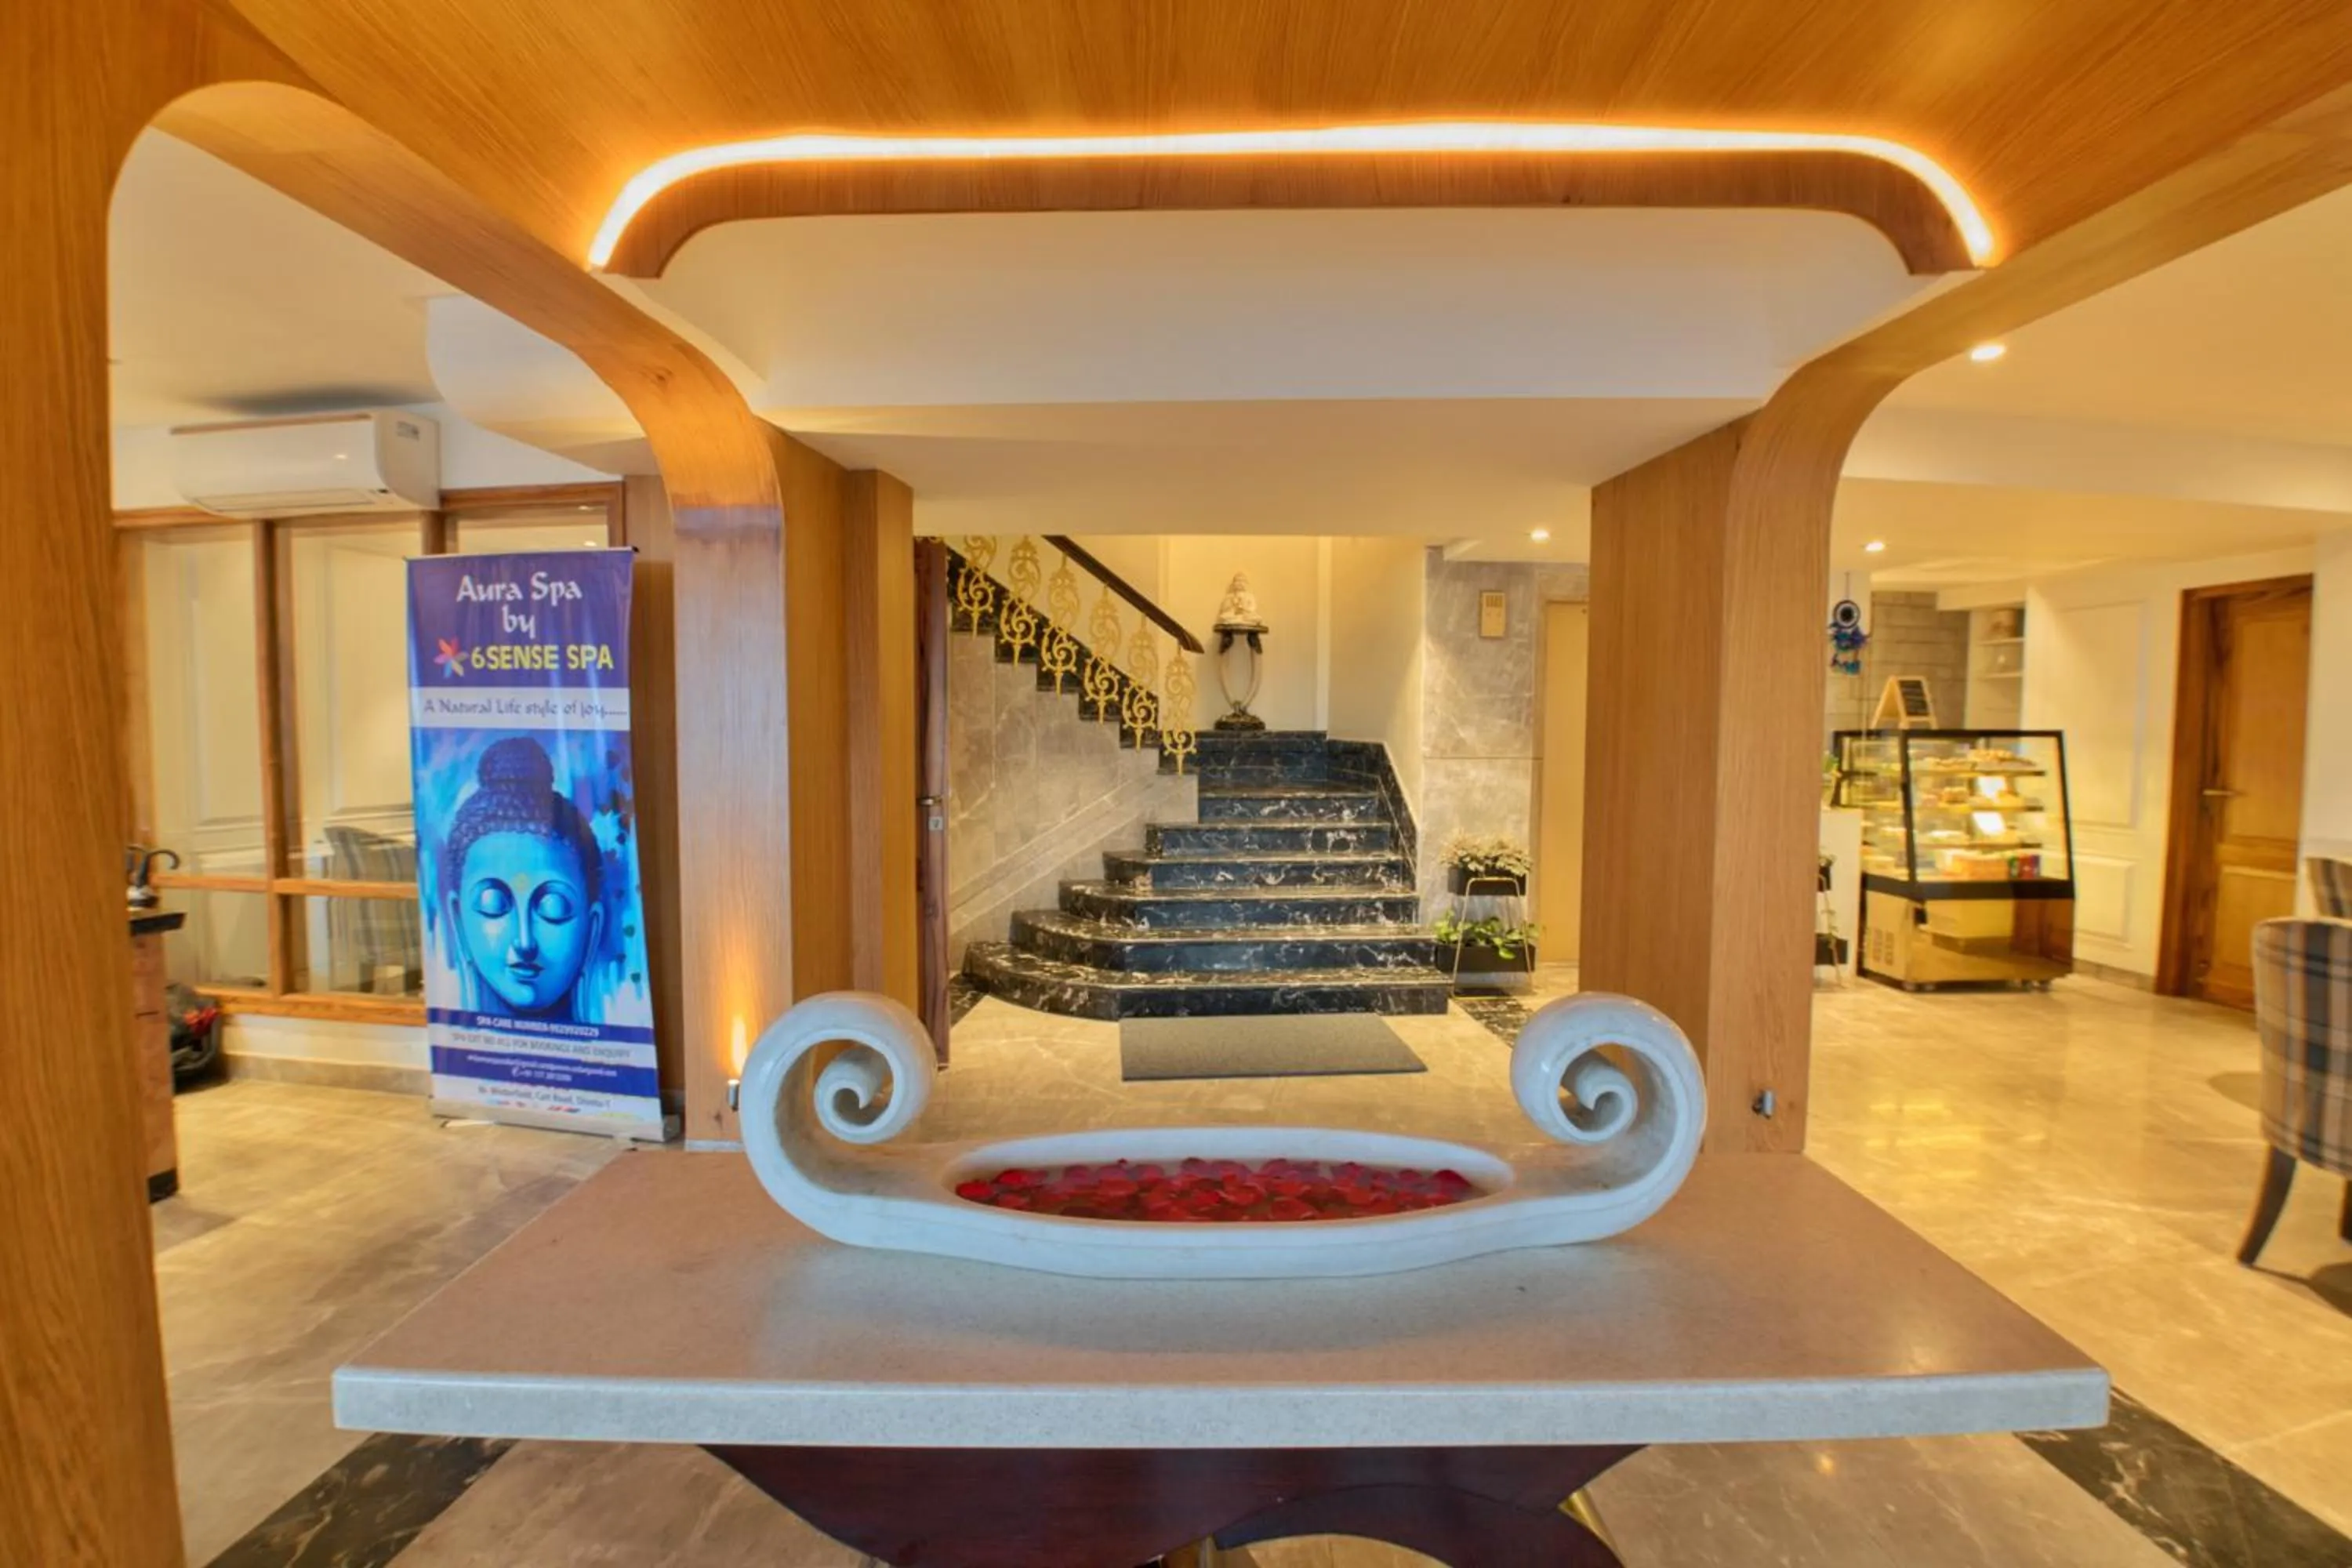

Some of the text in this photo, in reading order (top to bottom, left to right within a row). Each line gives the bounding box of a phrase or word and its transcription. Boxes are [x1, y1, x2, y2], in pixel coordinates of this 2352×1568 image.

[456, 572, 583, 606] Aura Spa
[502, 604, 536, 639] by
[471, 644, 614, 670] 6SENSE SPA
[424, 699, 435, 713] A
[437, 698, 492, 713] Natural
[495, 697, 521, 714] Life
[525, 699, 558, 718] style
[564, 699, 578, 714] of
